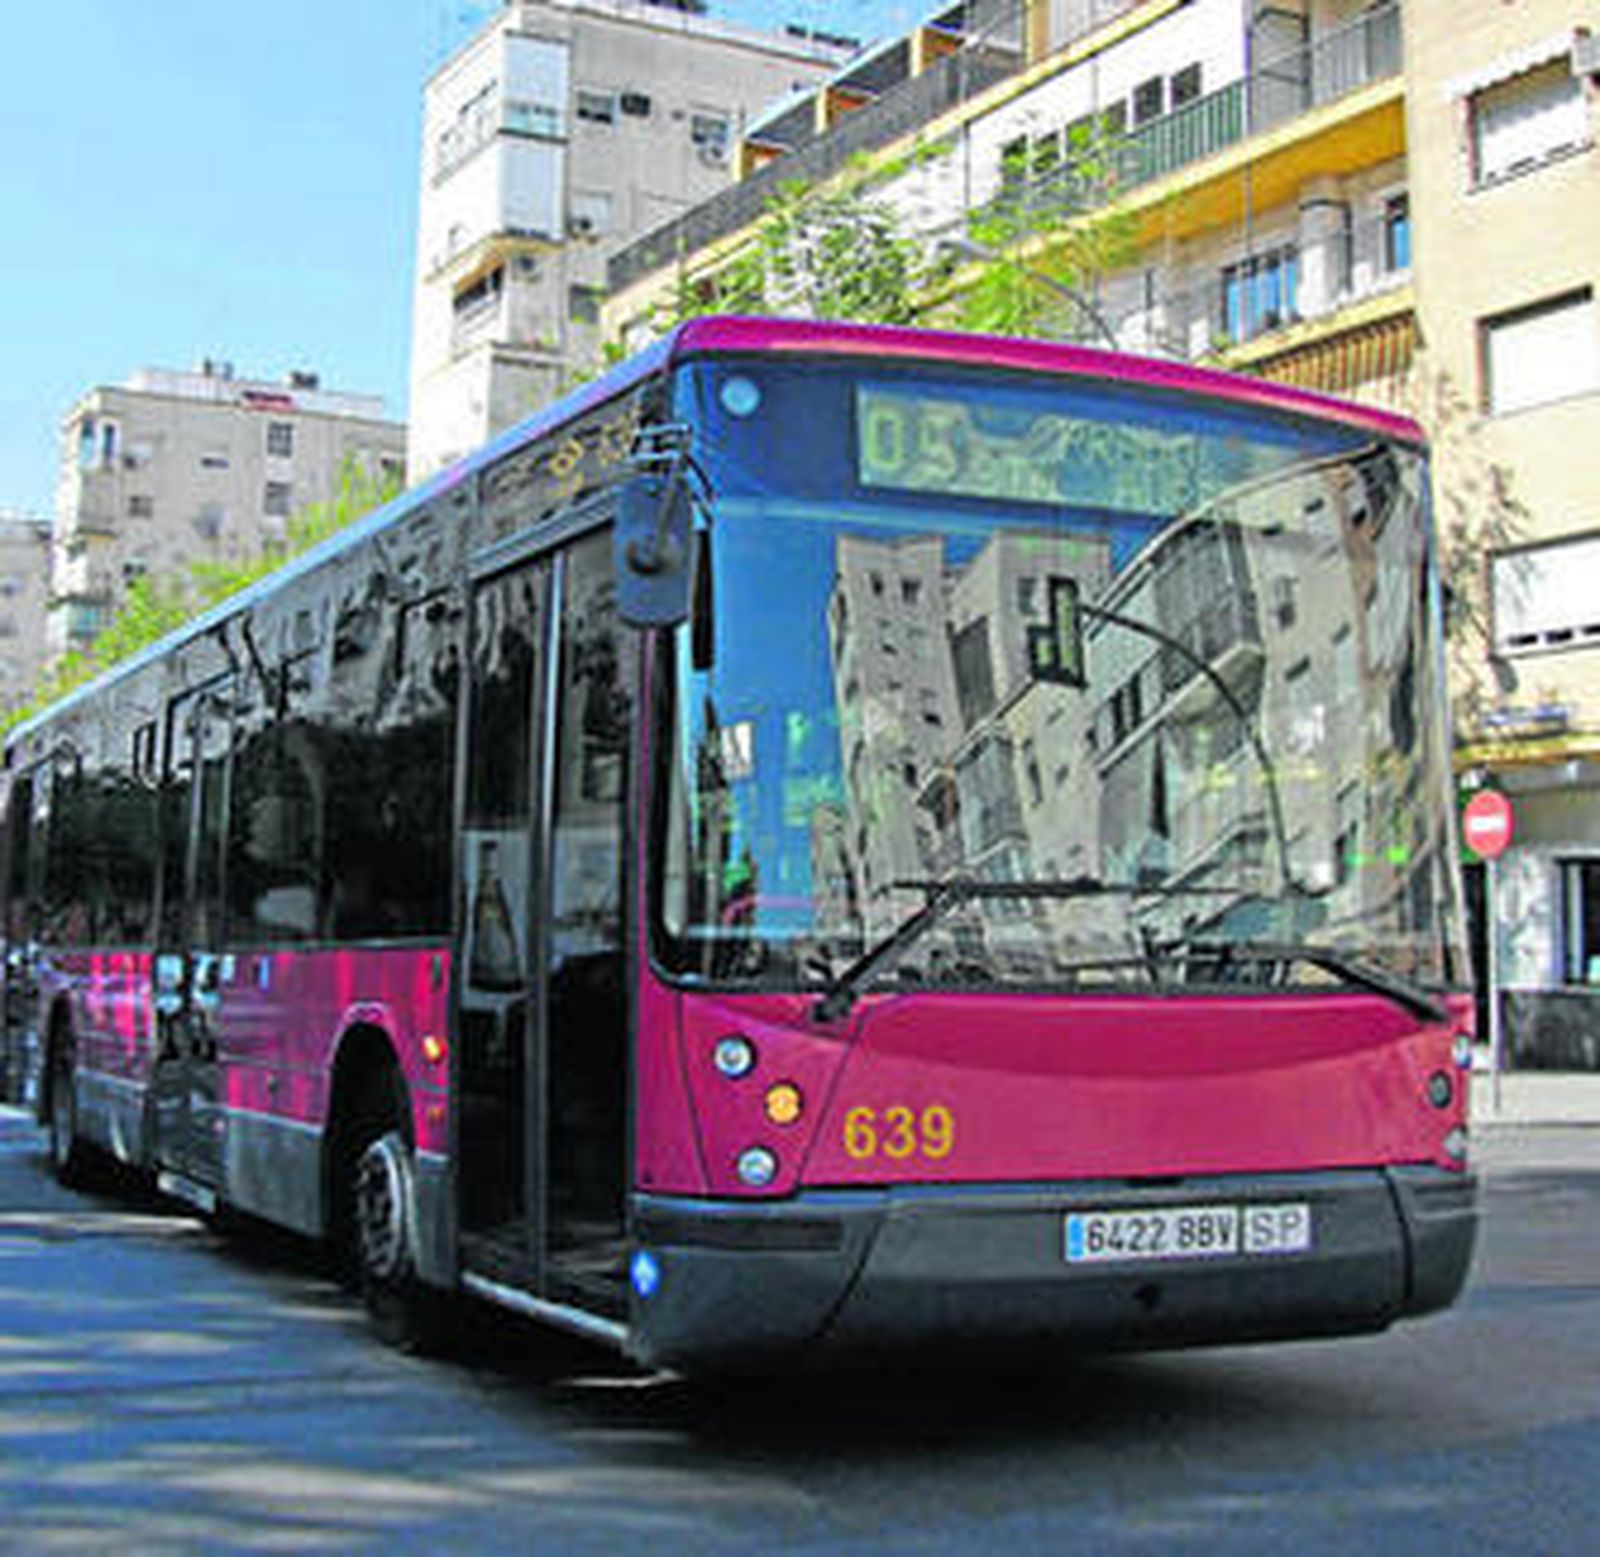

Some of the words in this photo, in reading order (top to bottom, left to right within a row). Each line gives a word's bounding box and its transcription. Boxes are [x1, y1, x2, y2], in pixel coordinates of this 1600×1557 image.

[844, 1105, 954, 1159] 639
[1087, 1217, 1167, 1253] 6422
[1252, 1211, 1301, 1247] SP
